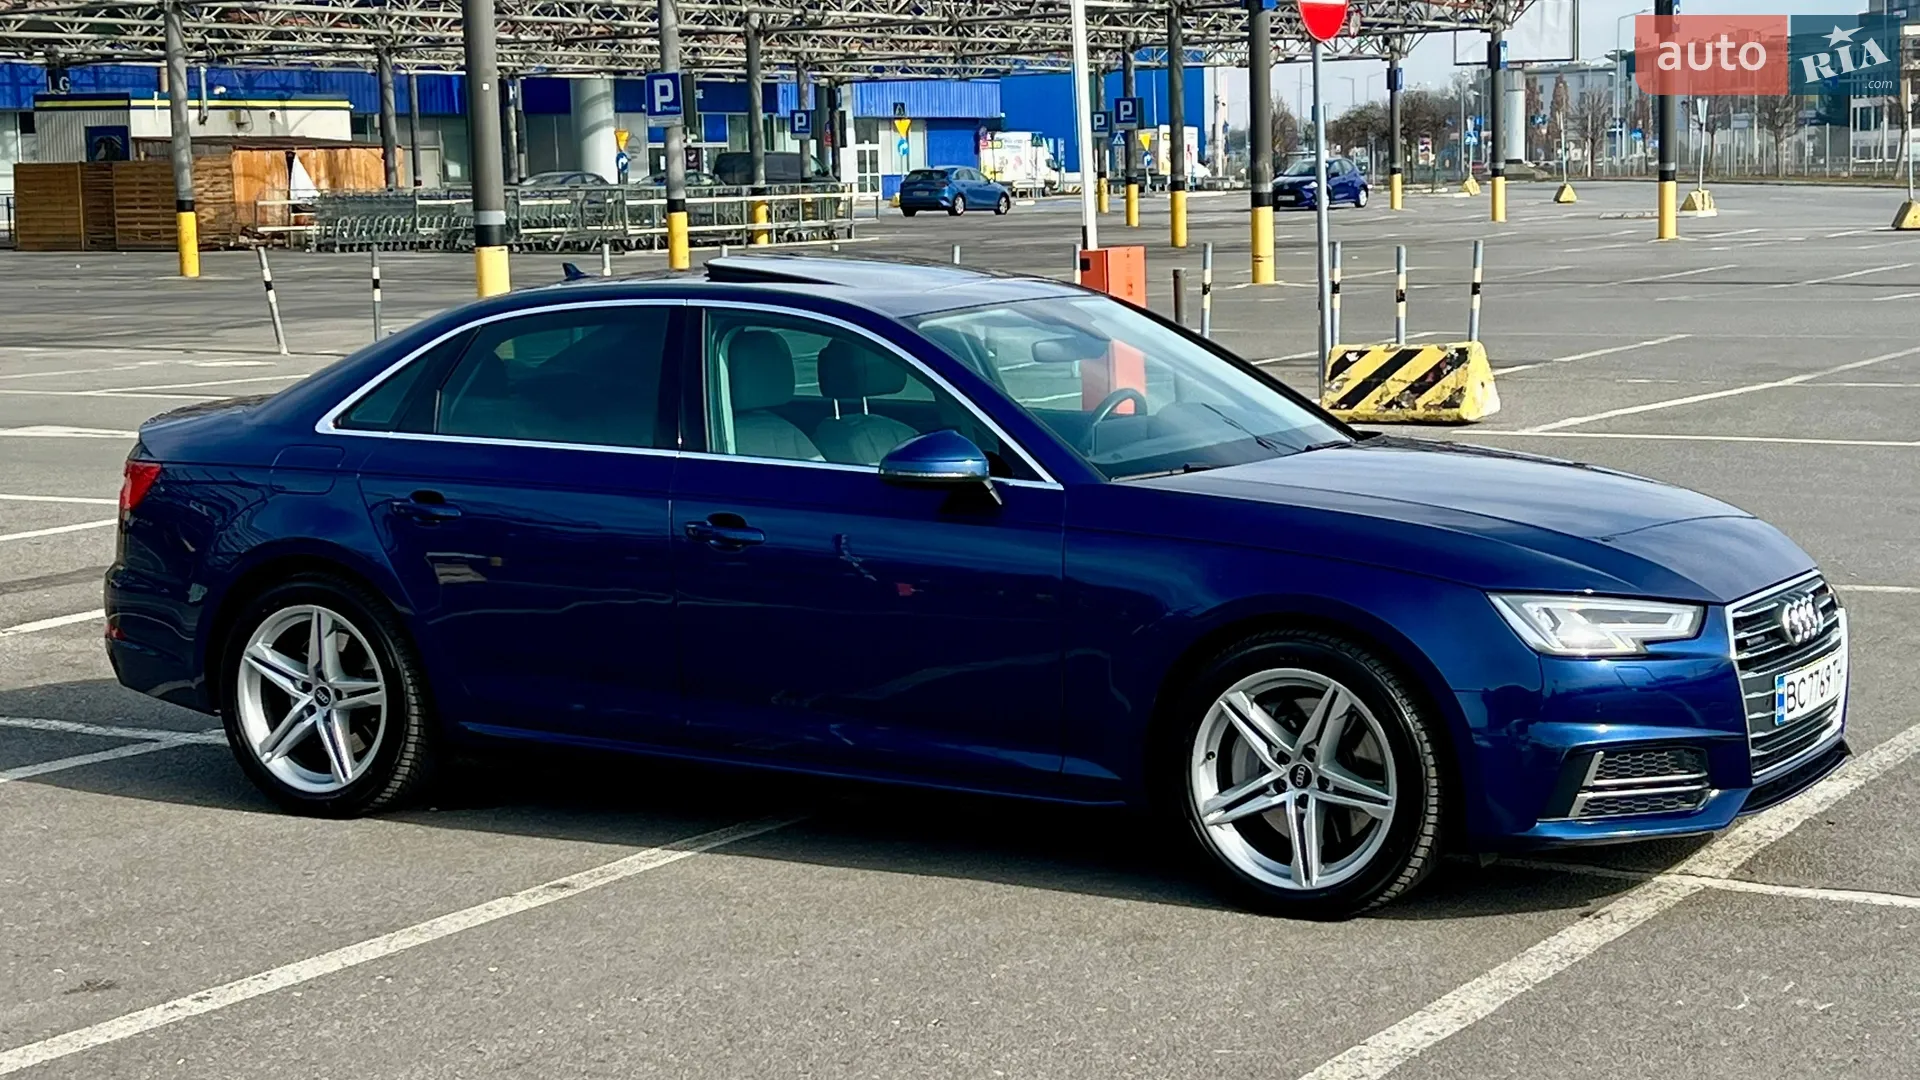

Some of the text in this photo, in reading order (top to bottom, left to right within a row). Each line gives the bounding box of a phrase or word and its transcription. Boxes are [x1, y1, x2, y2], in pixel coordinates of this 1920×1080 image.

[654, 79, 674, 112] P
[1120, 101, 1133, 121] P
[794, 112, 806, 131] P
[1094, 114, 1105, 130] P
